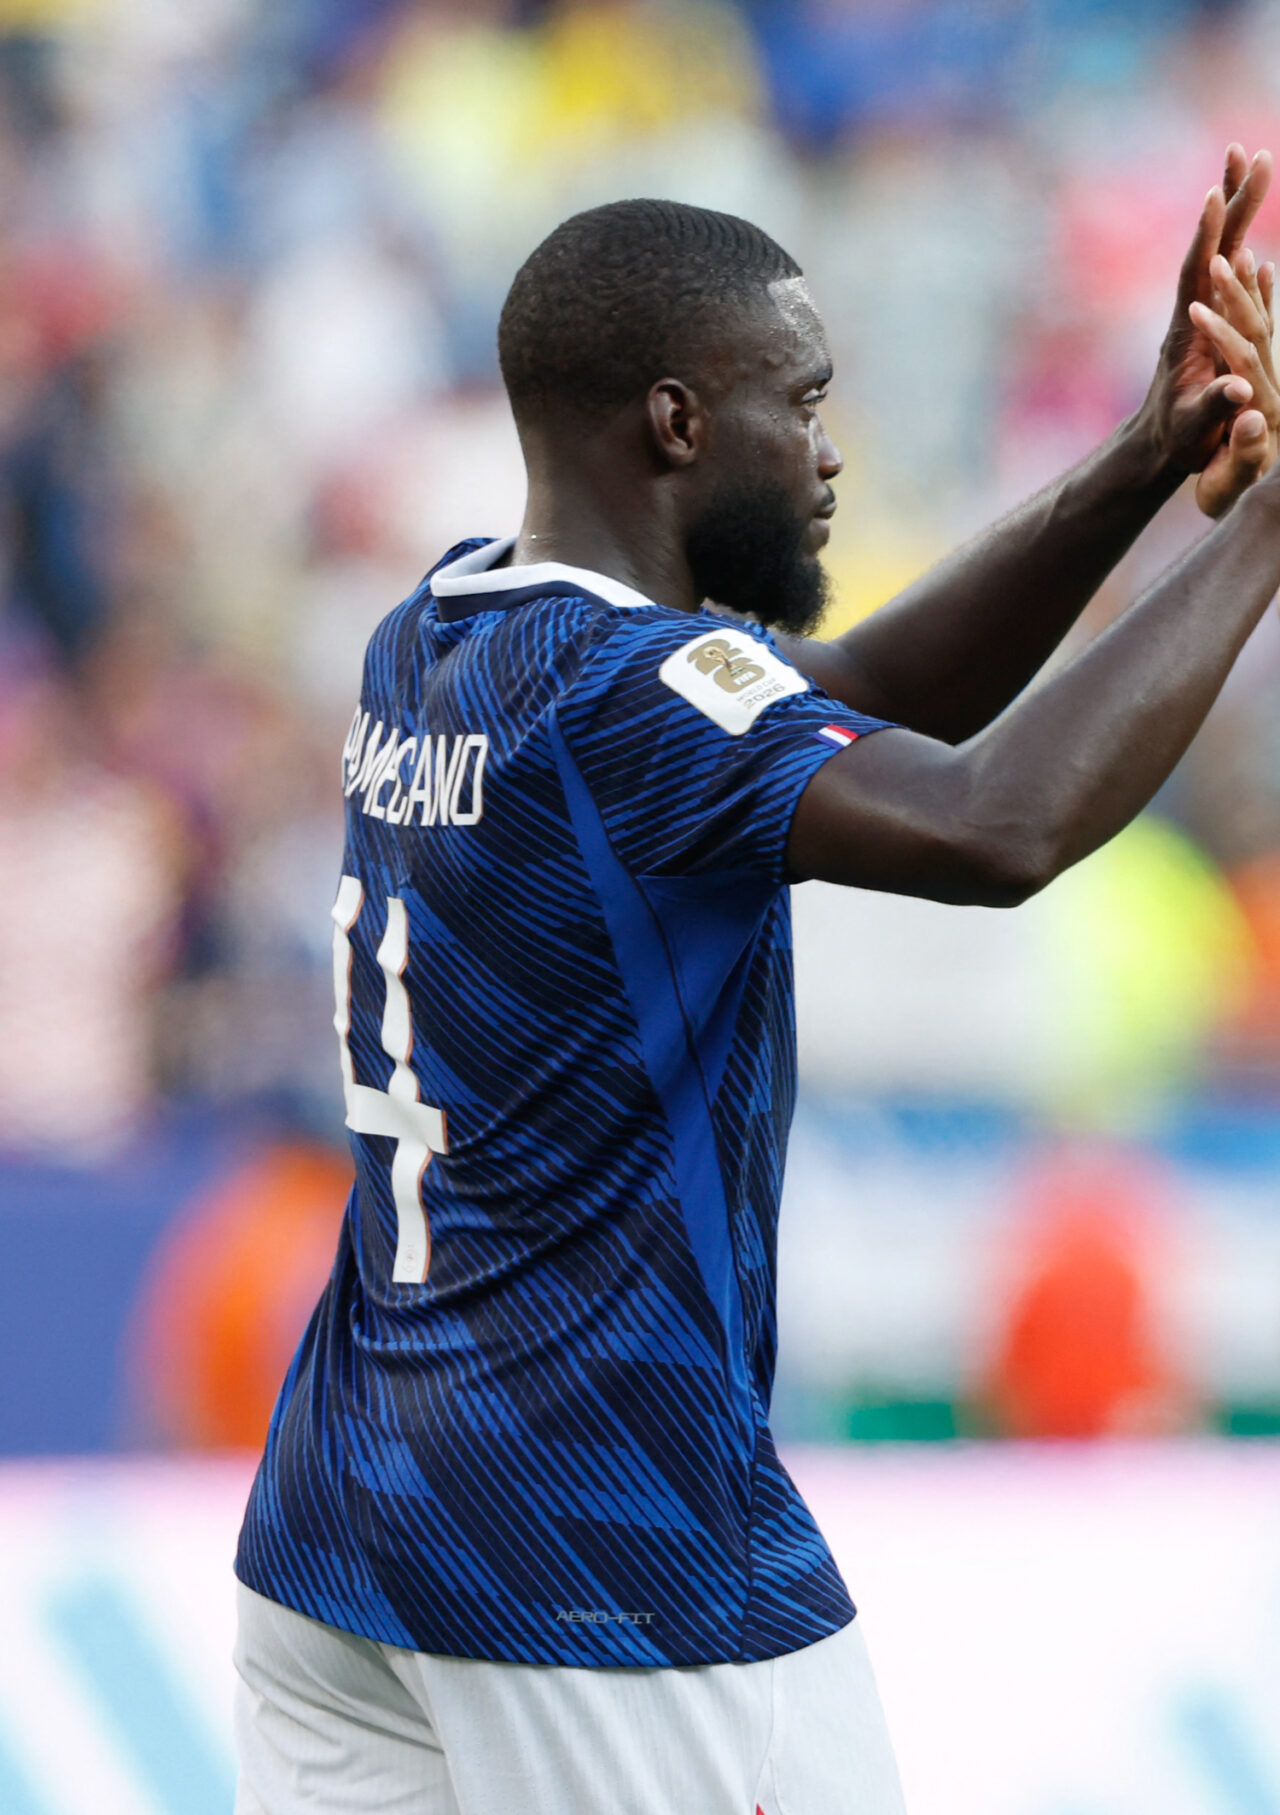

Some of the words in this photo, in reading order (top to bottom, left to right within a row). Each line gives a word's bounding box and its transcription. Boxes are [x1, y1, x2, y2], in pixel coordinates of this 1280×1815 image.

[743, 683, 786, 709] 2026
[331, 874, 449, 1283] 4
[556, 1610, 656, 1625] AERO-FIT
